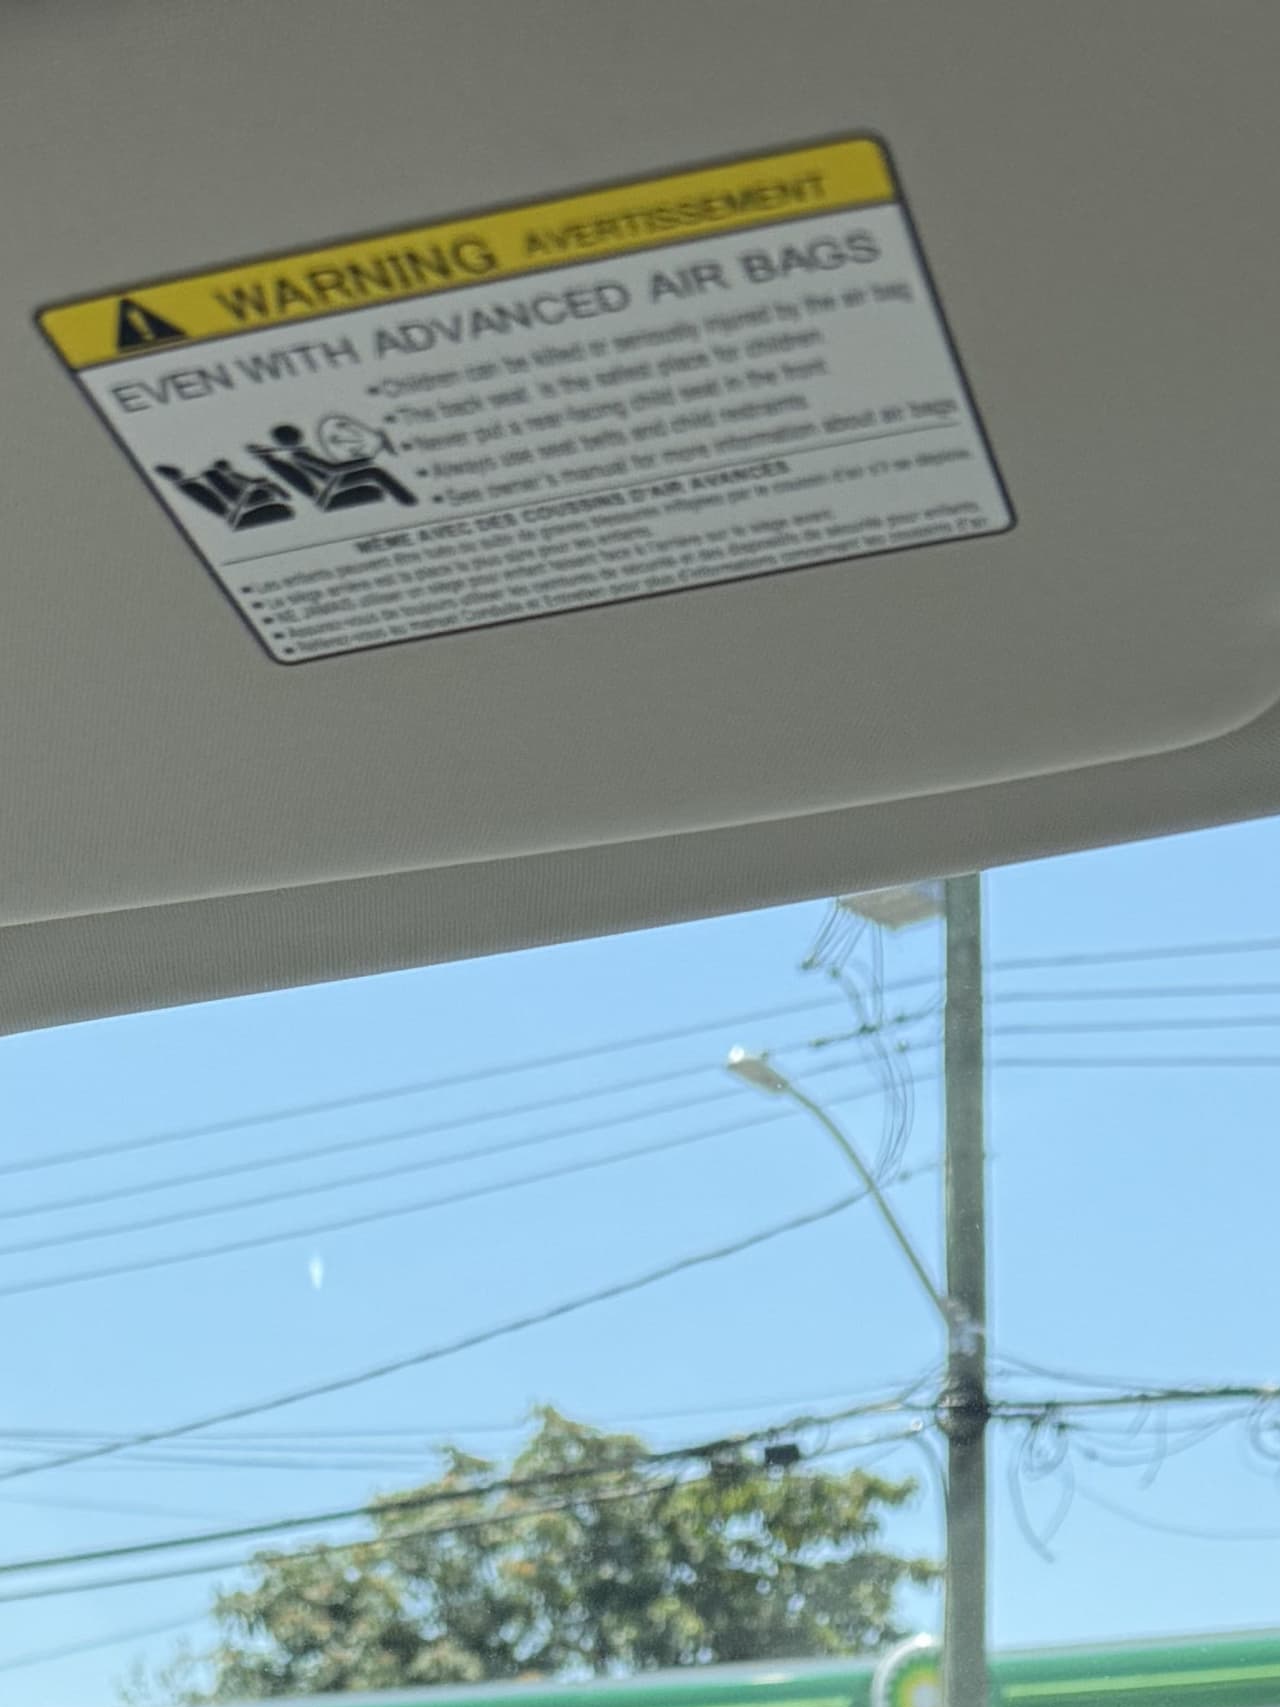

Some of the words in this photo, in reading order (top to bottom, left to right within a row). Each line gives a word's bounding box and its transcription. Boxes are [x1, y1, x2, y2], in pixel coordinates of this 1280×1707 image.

[517, 169, 831, 261] AVERTISSEMENT
[108, 363, 238, 414] EVEN
[231, 337, 363, 389] WITH
[365, 279, 637, 361] ADVANCED
[642, 260, 731, 305] AIR
[739, 228, 883, 285] BAGS
[212, 234, 501, 326] WARNING
